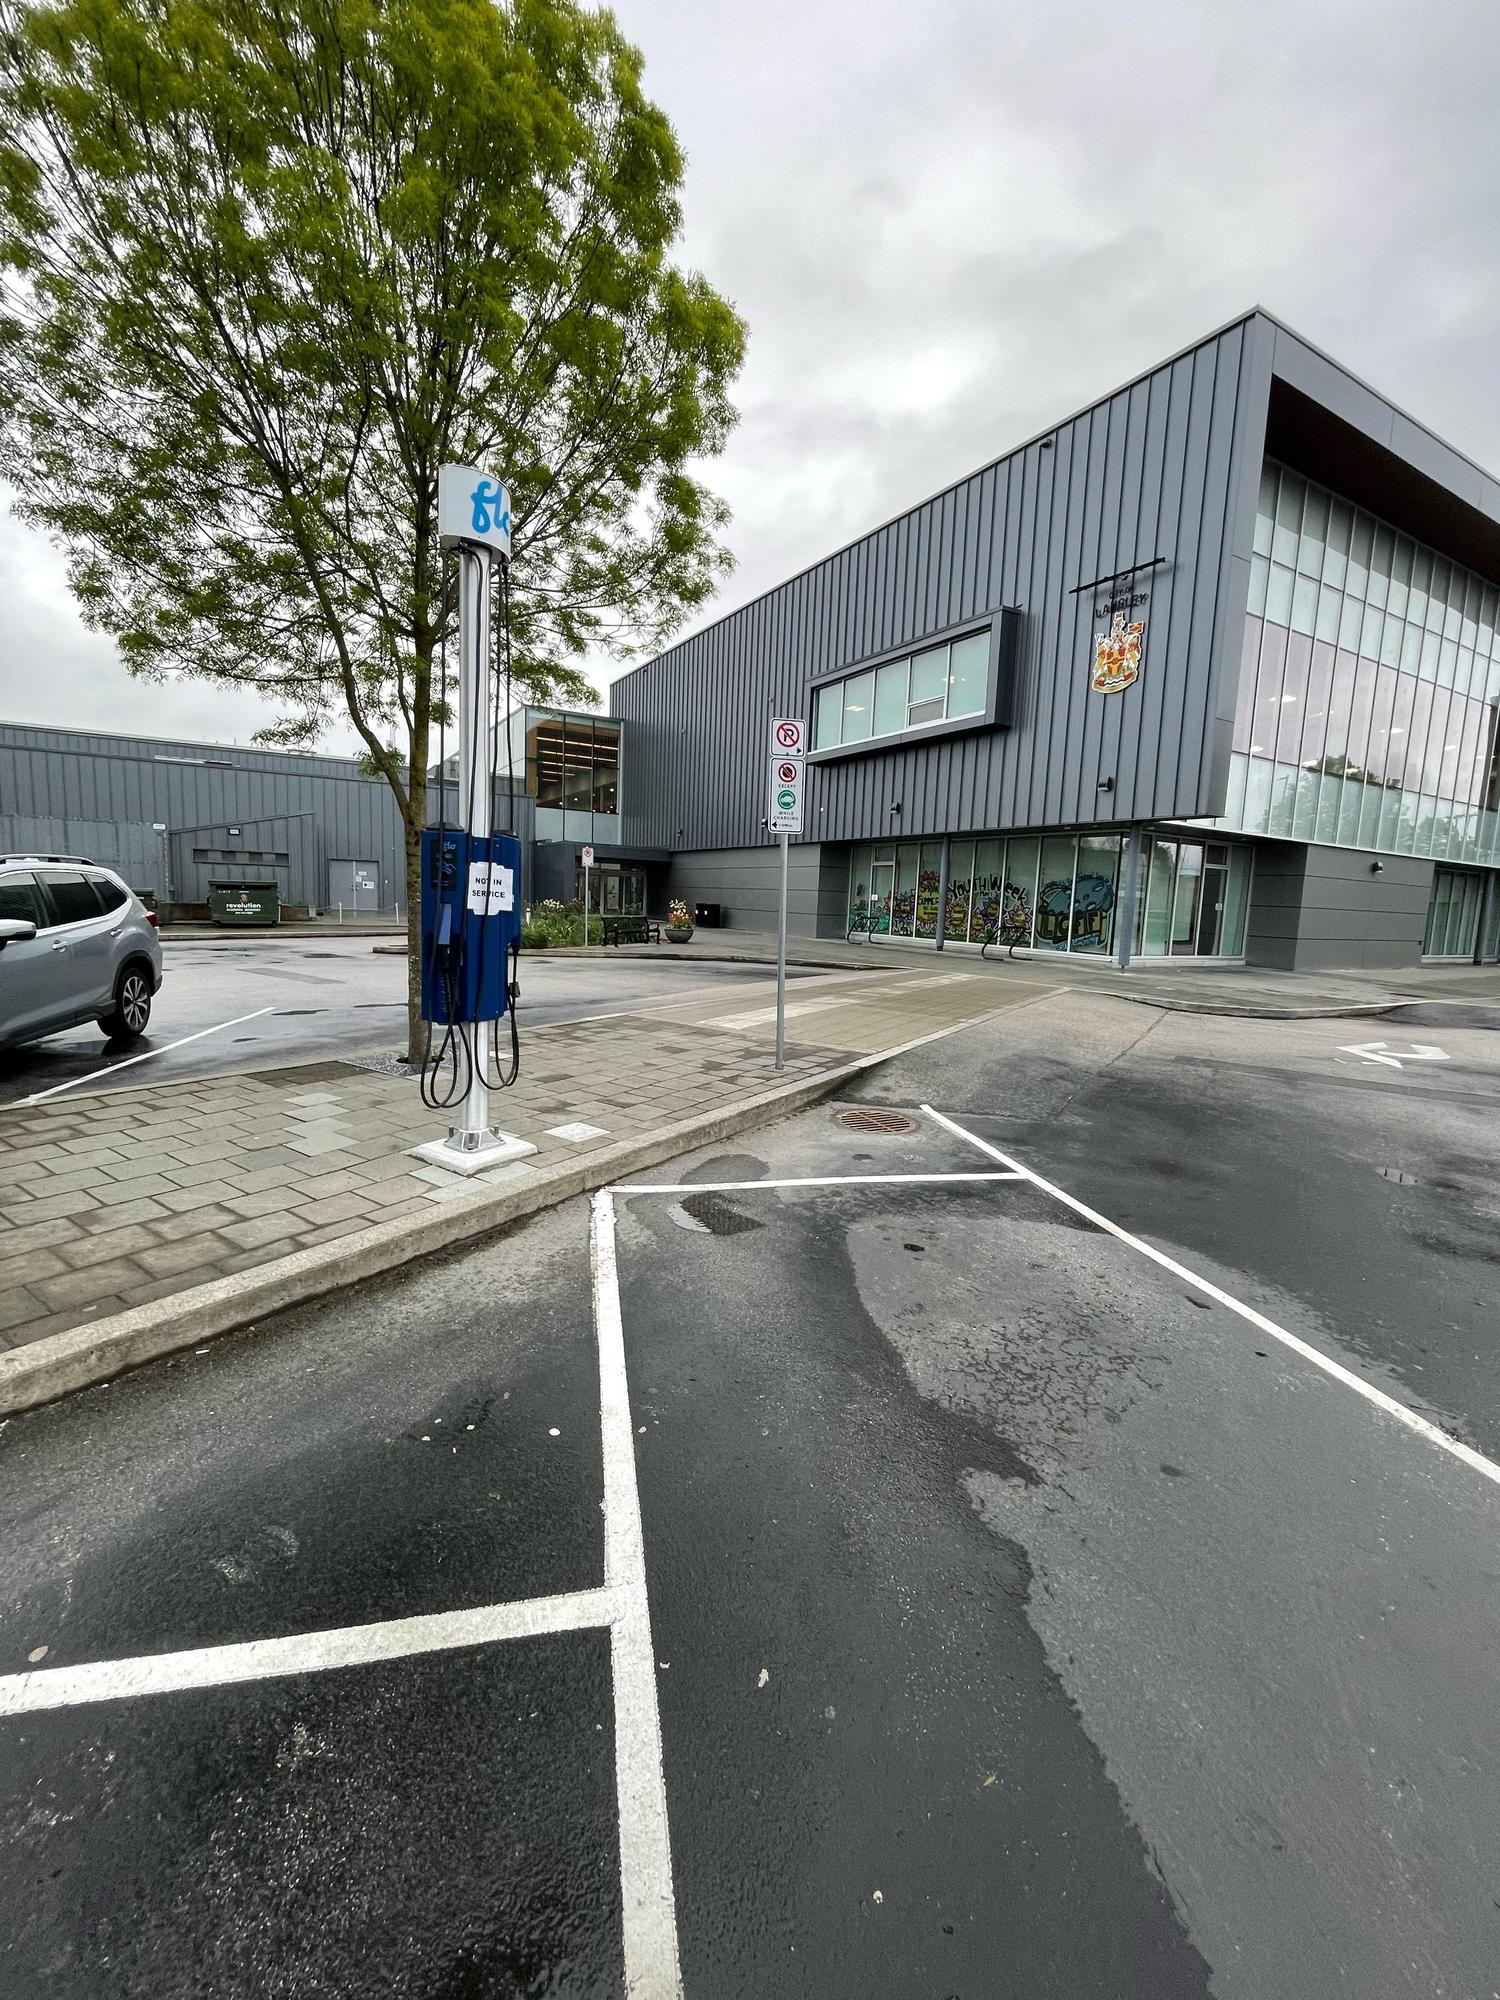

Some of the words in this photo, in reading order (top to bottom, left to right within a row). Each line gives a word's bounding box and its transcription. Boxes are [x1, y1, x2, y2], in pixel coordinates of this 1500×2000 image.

[1095, 593, 1148, 618] LANGLEY
[475, 877, 490, 885] NO
[493, 878, 502, 886] IN
